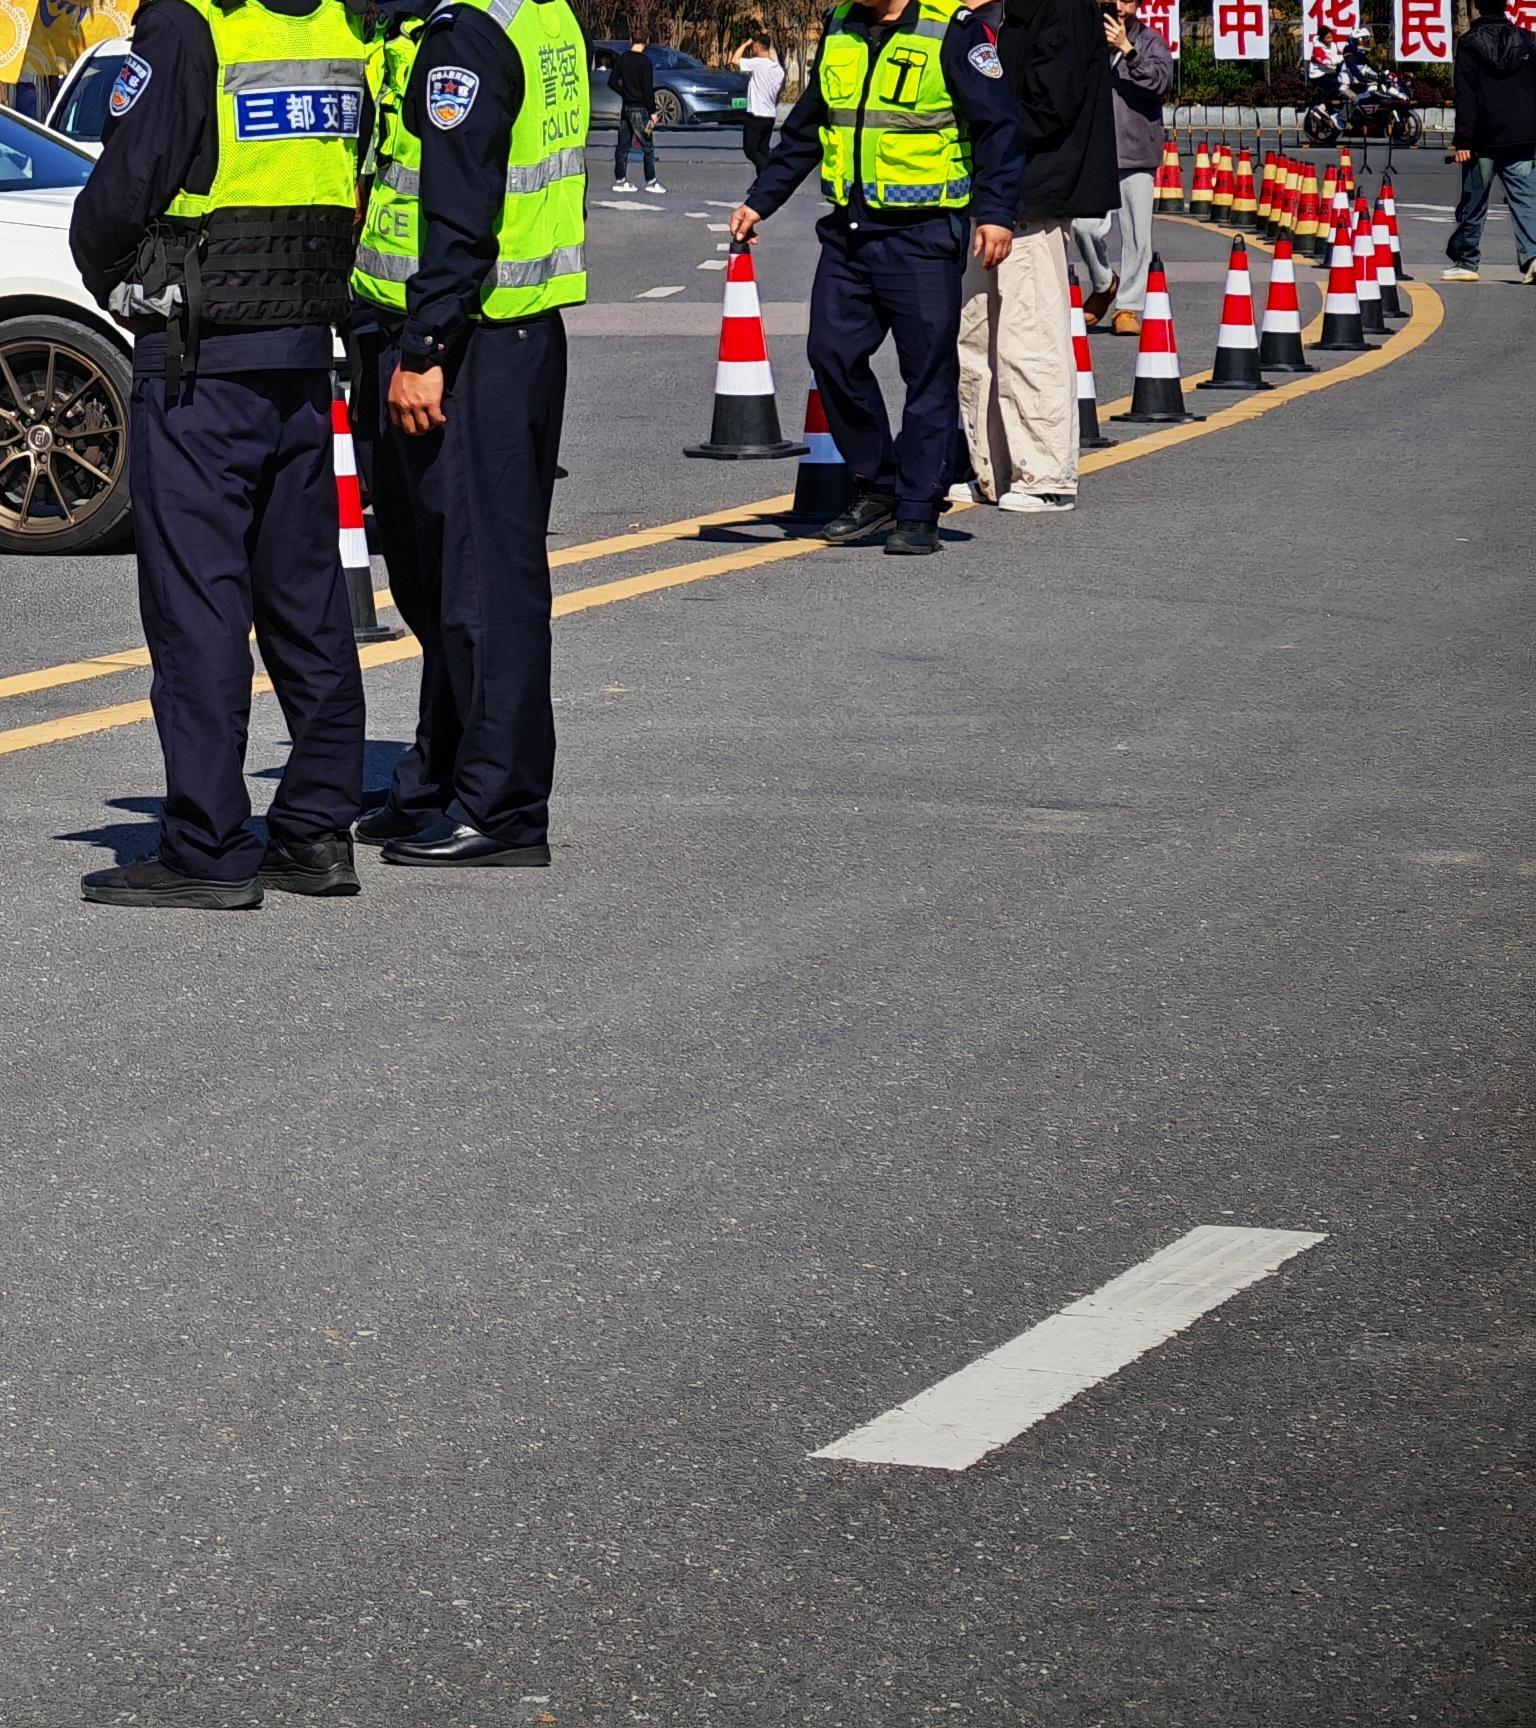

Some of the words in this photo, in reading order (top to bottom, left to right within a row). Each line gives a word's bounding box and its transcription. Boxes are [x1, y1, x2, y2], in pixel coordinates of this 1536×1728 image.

[537, 40, 581, 110] 警察
[245, 93, 358, 132] 三都交警
